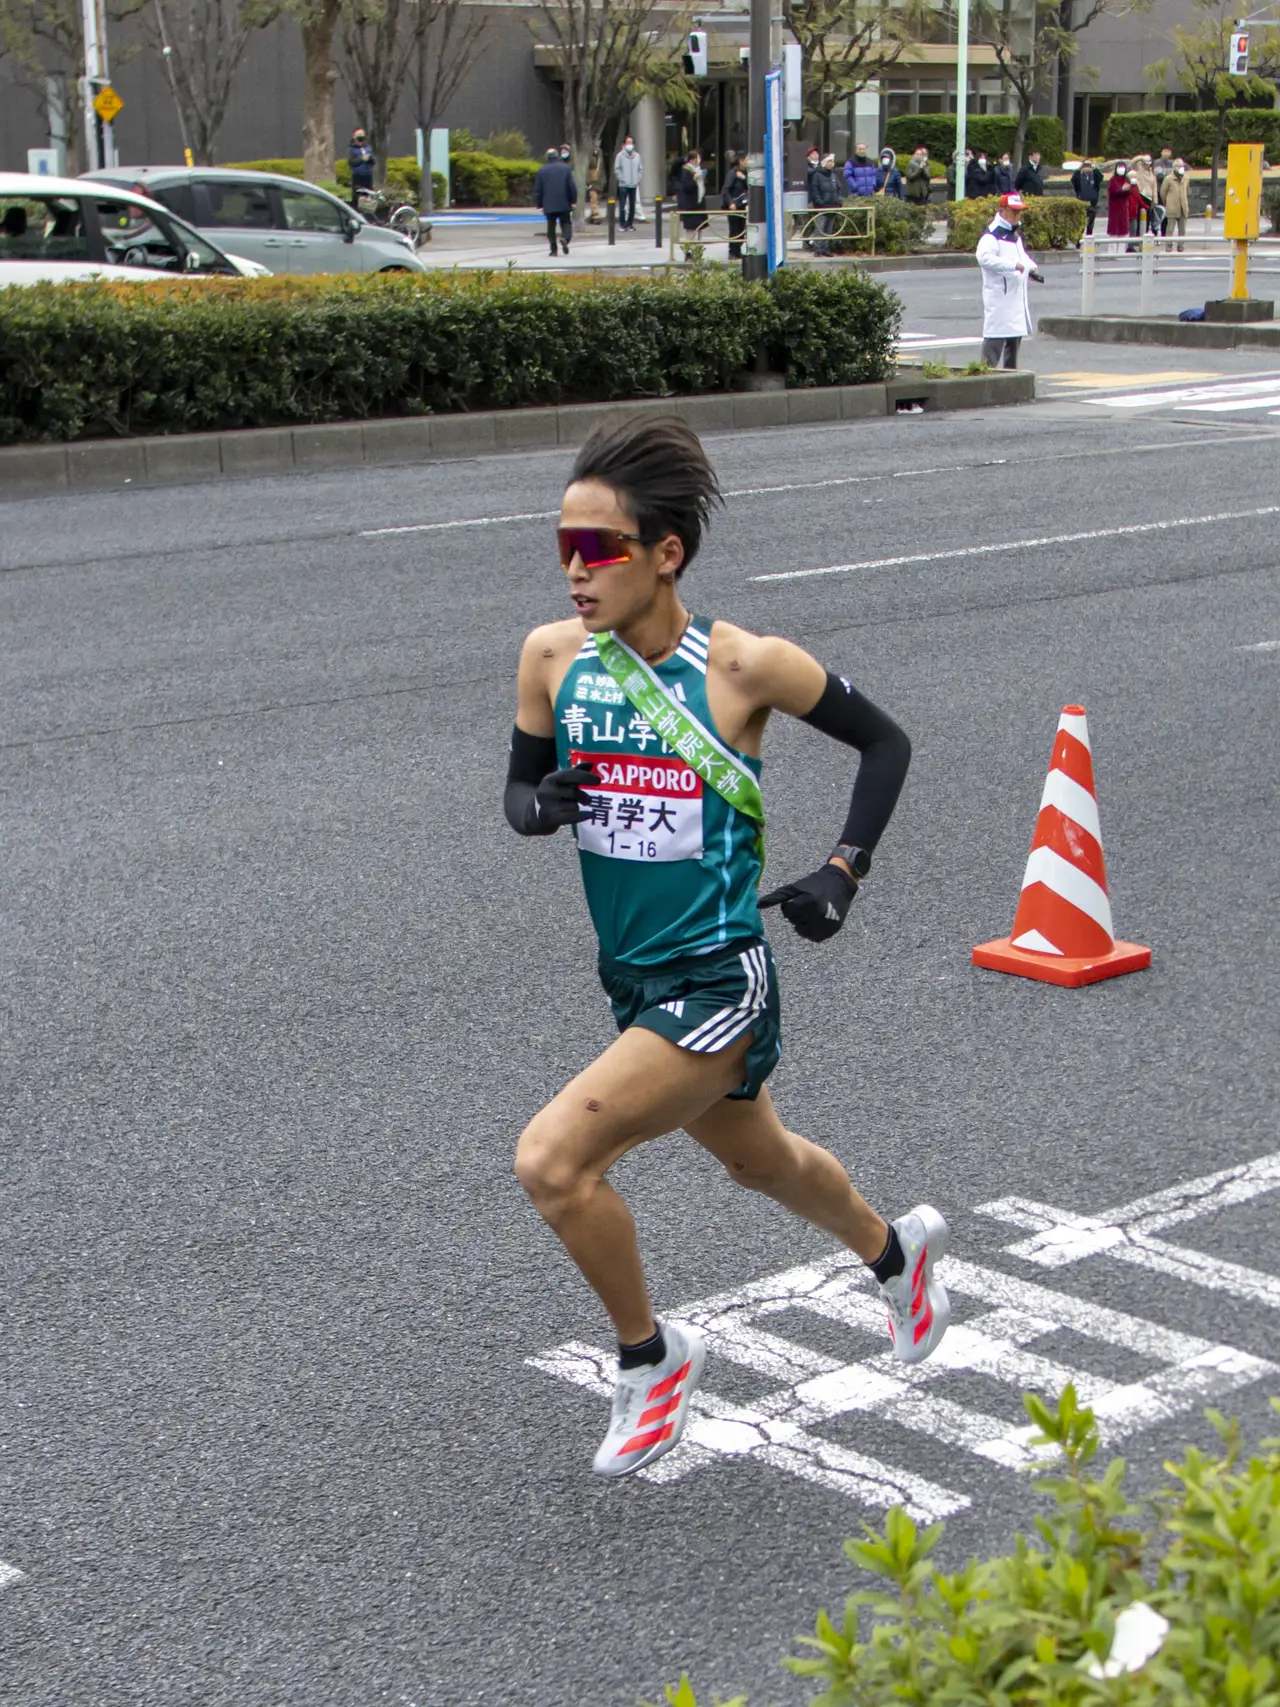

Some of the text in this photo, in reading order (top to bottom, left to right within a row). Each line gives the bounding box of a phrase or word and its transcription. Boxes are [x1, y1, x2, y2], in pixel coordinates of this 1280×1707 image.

[560, 703, 677, 753] 青山学
[622, 669, 741, 796] 青山学院大学
[596, 762, 697, 792] SAPPORO
[587, 794, 677, 834] 青学大
